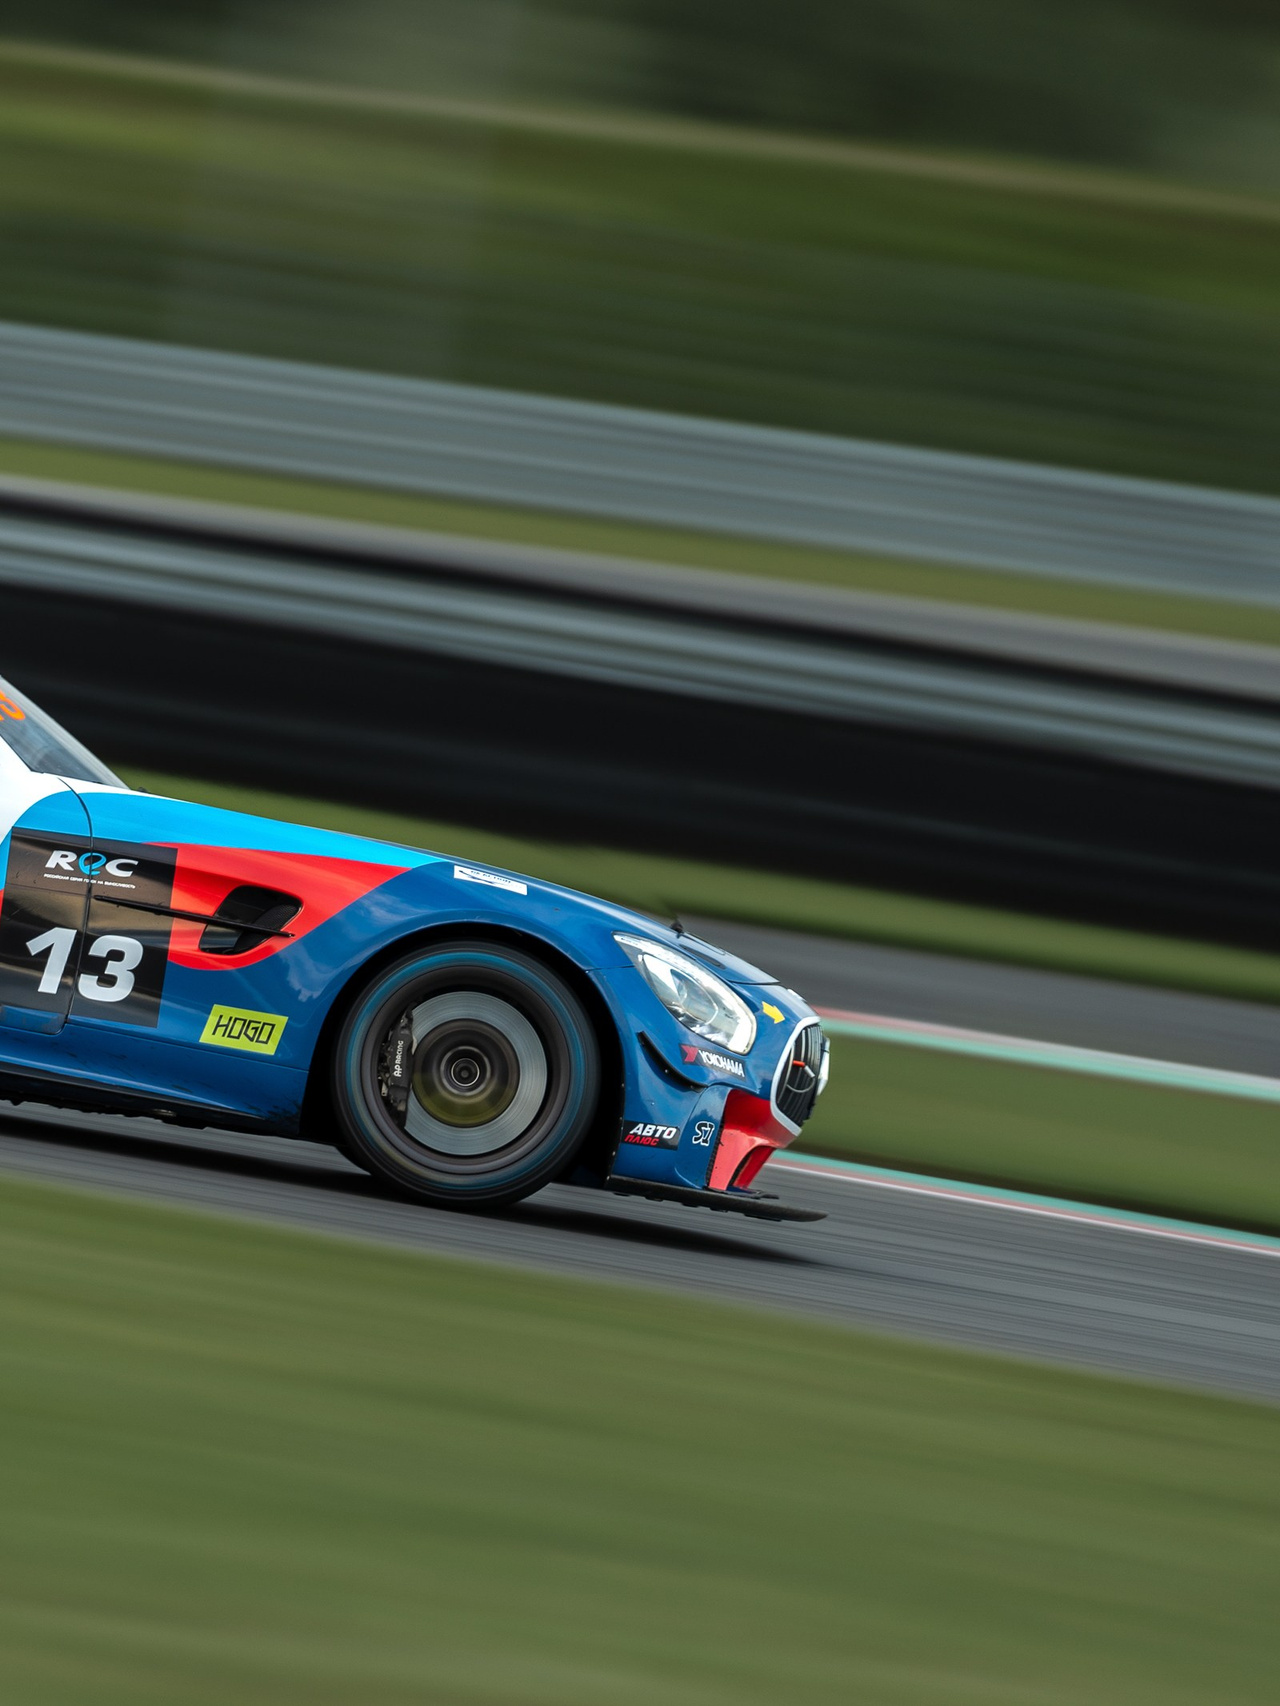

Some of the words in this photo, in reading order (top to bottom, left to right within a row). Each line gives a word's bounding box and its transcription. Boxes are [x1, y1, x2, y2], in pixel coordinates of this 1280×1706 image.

[26, 926, 144, 1003] 13
[212, 1014, 276, 1045] HOGO
[698, 1049, 745, 1078] YOKOHAMA
[624, 1134, 660, 1146] ПЛЮС
[629, 1123, 678, 1140] АВТО
